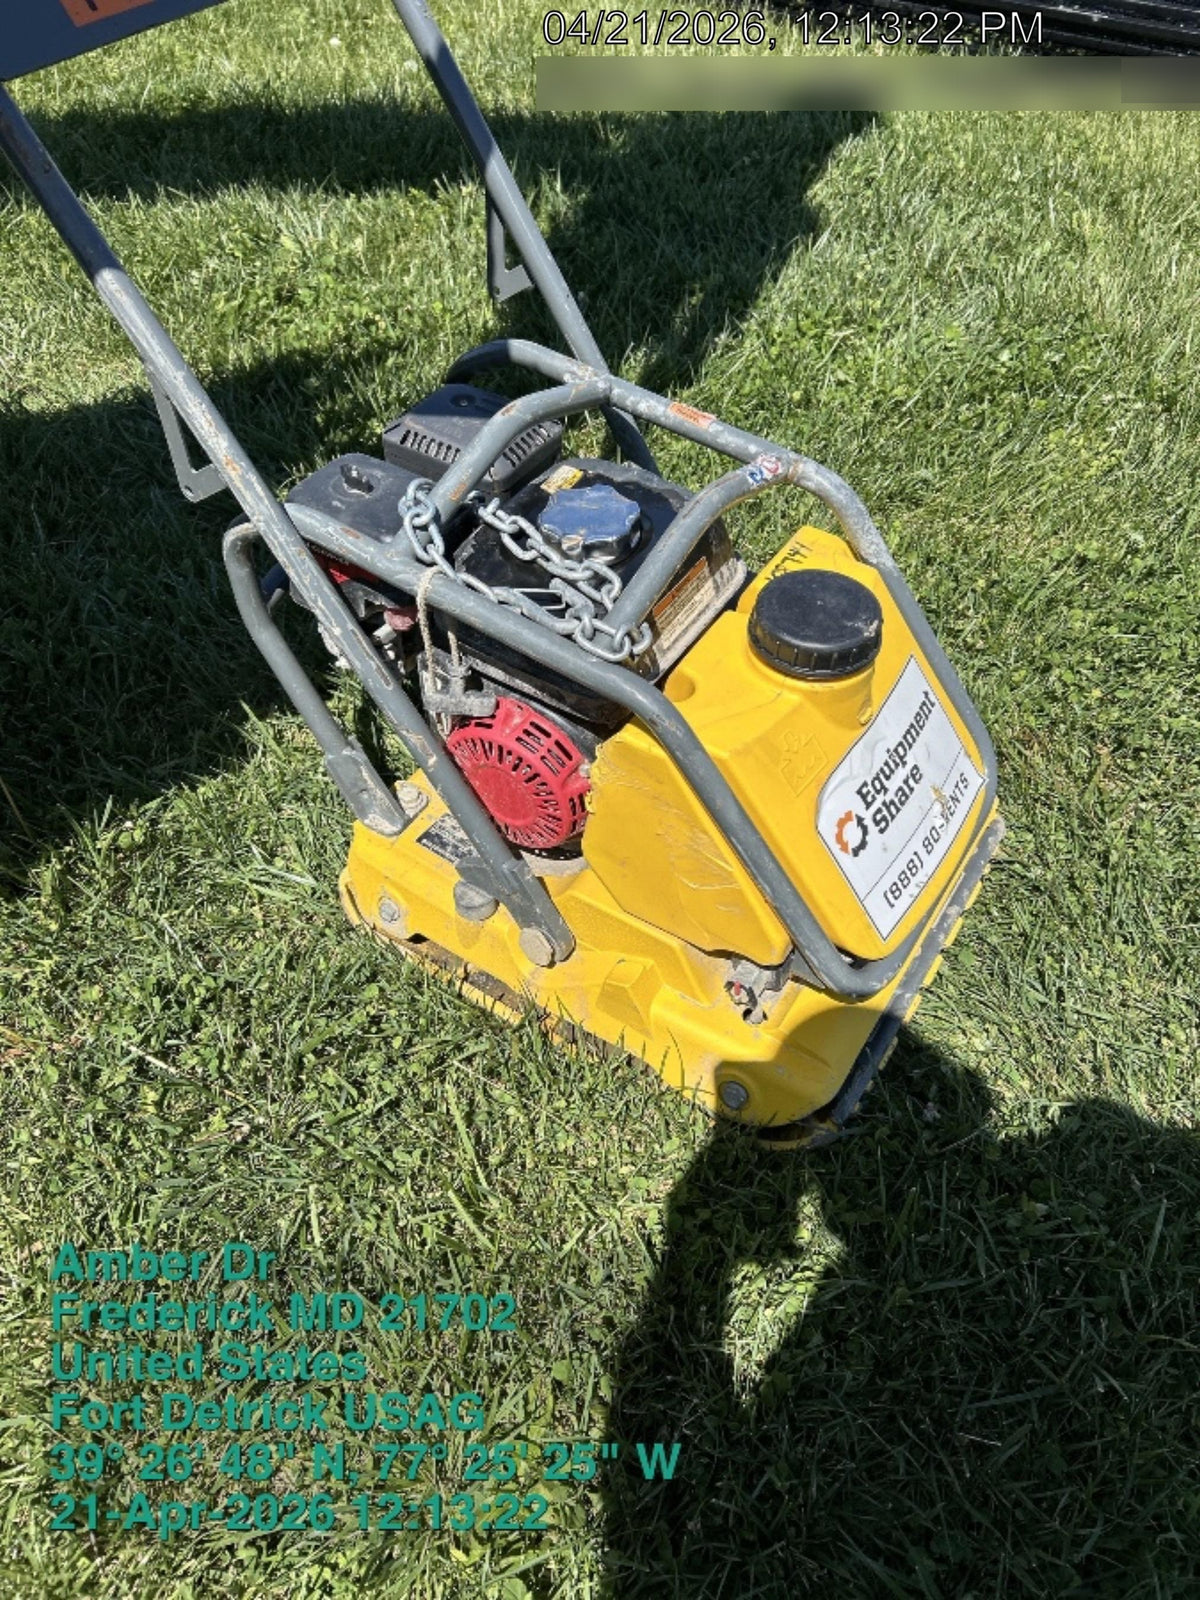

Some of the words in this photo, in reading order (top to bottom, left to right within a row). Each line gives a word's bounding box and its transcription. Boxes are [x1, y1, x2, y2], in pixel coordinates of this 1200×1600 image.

[856, 690, 937, 811] Equipment
[872, 763, 923, 835] Share
[882, 851, 924, 909] (888)
